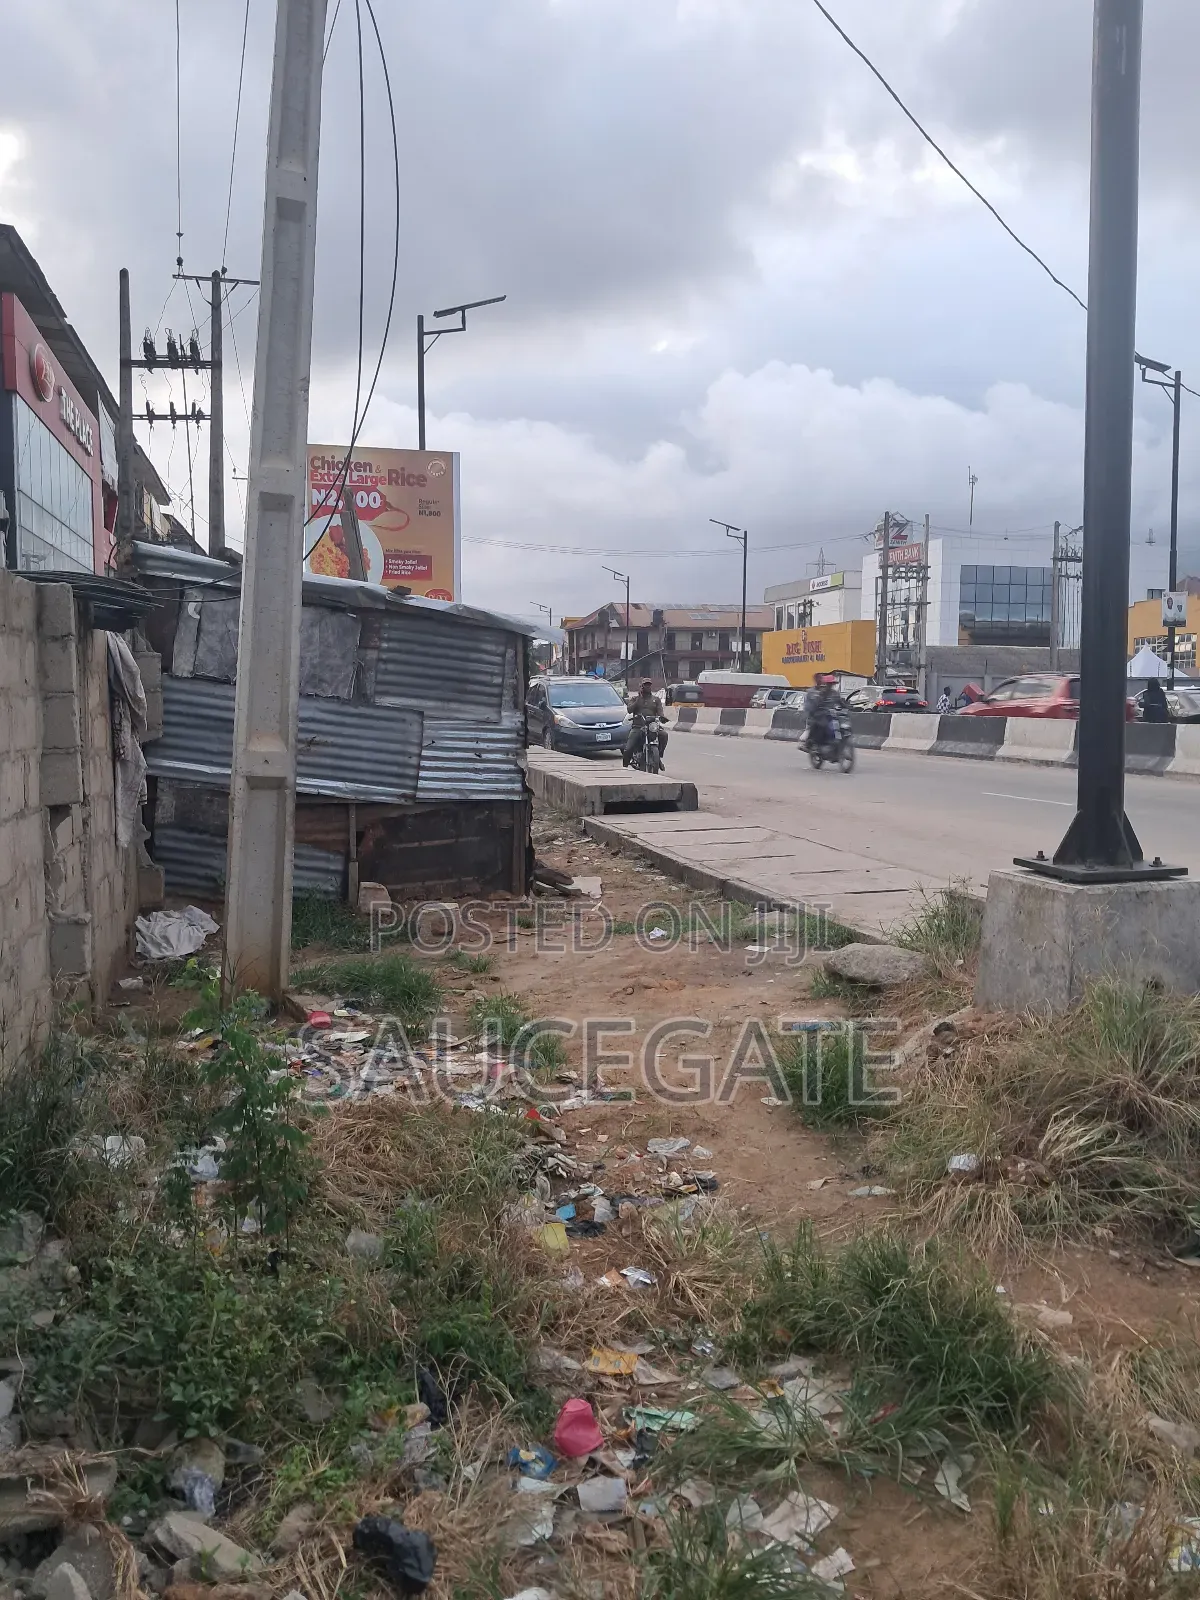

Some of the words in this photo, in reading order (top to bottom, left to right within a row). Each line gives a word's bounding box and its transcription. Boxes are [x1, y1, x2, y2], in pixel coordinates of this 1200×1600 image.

[59, 386, 75, 431] THE
[310, 455, 373, 473] Chicken
[375, 465, 381, 473] &
[310, 471, 344, 484] Extra
[349, 471, 387, 488] Large
[387, 467, 427, 487] Rice
[311, 488, 381, 509] N2,00
[786, 641, 801, 655] BIG
[803, 640, 822, 654] FISH
